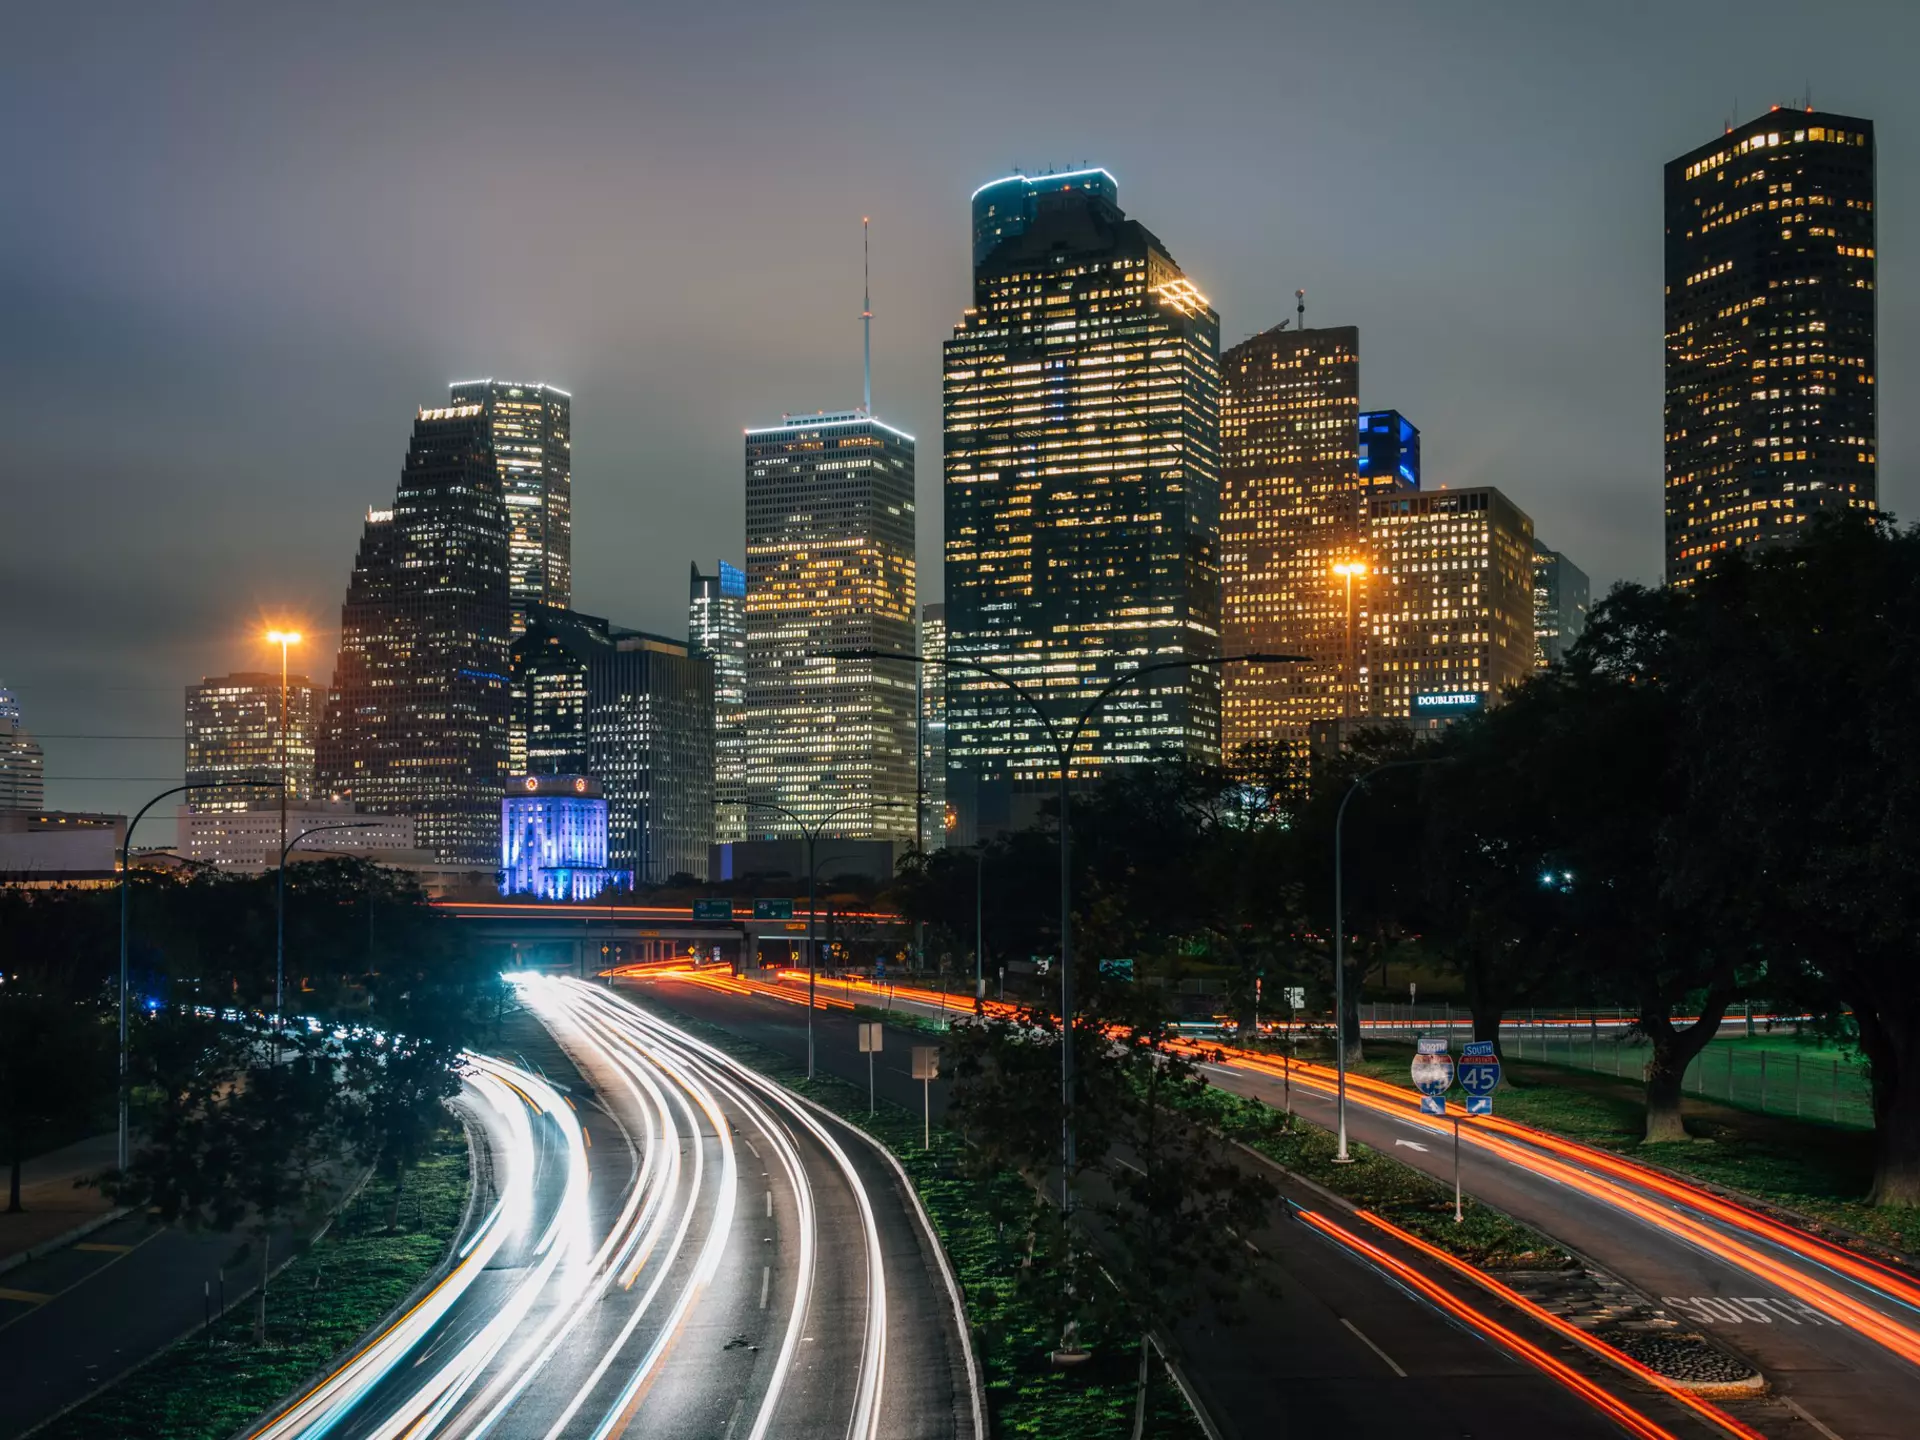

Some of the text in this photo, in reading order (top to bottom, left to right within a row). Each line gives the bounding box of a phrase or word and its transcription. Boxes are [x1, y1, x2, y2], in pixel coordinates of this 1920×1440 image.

[1418, 694, 1476, 705] DOUBLETREE
[1420, 1042, 1446, 1052] NORTH
[1466, 1045, 1492, 1055] SOUTH
[1463, 1068, 1495, 1090] 45
[1660, 1297, 1842, 1325] SOUTH
